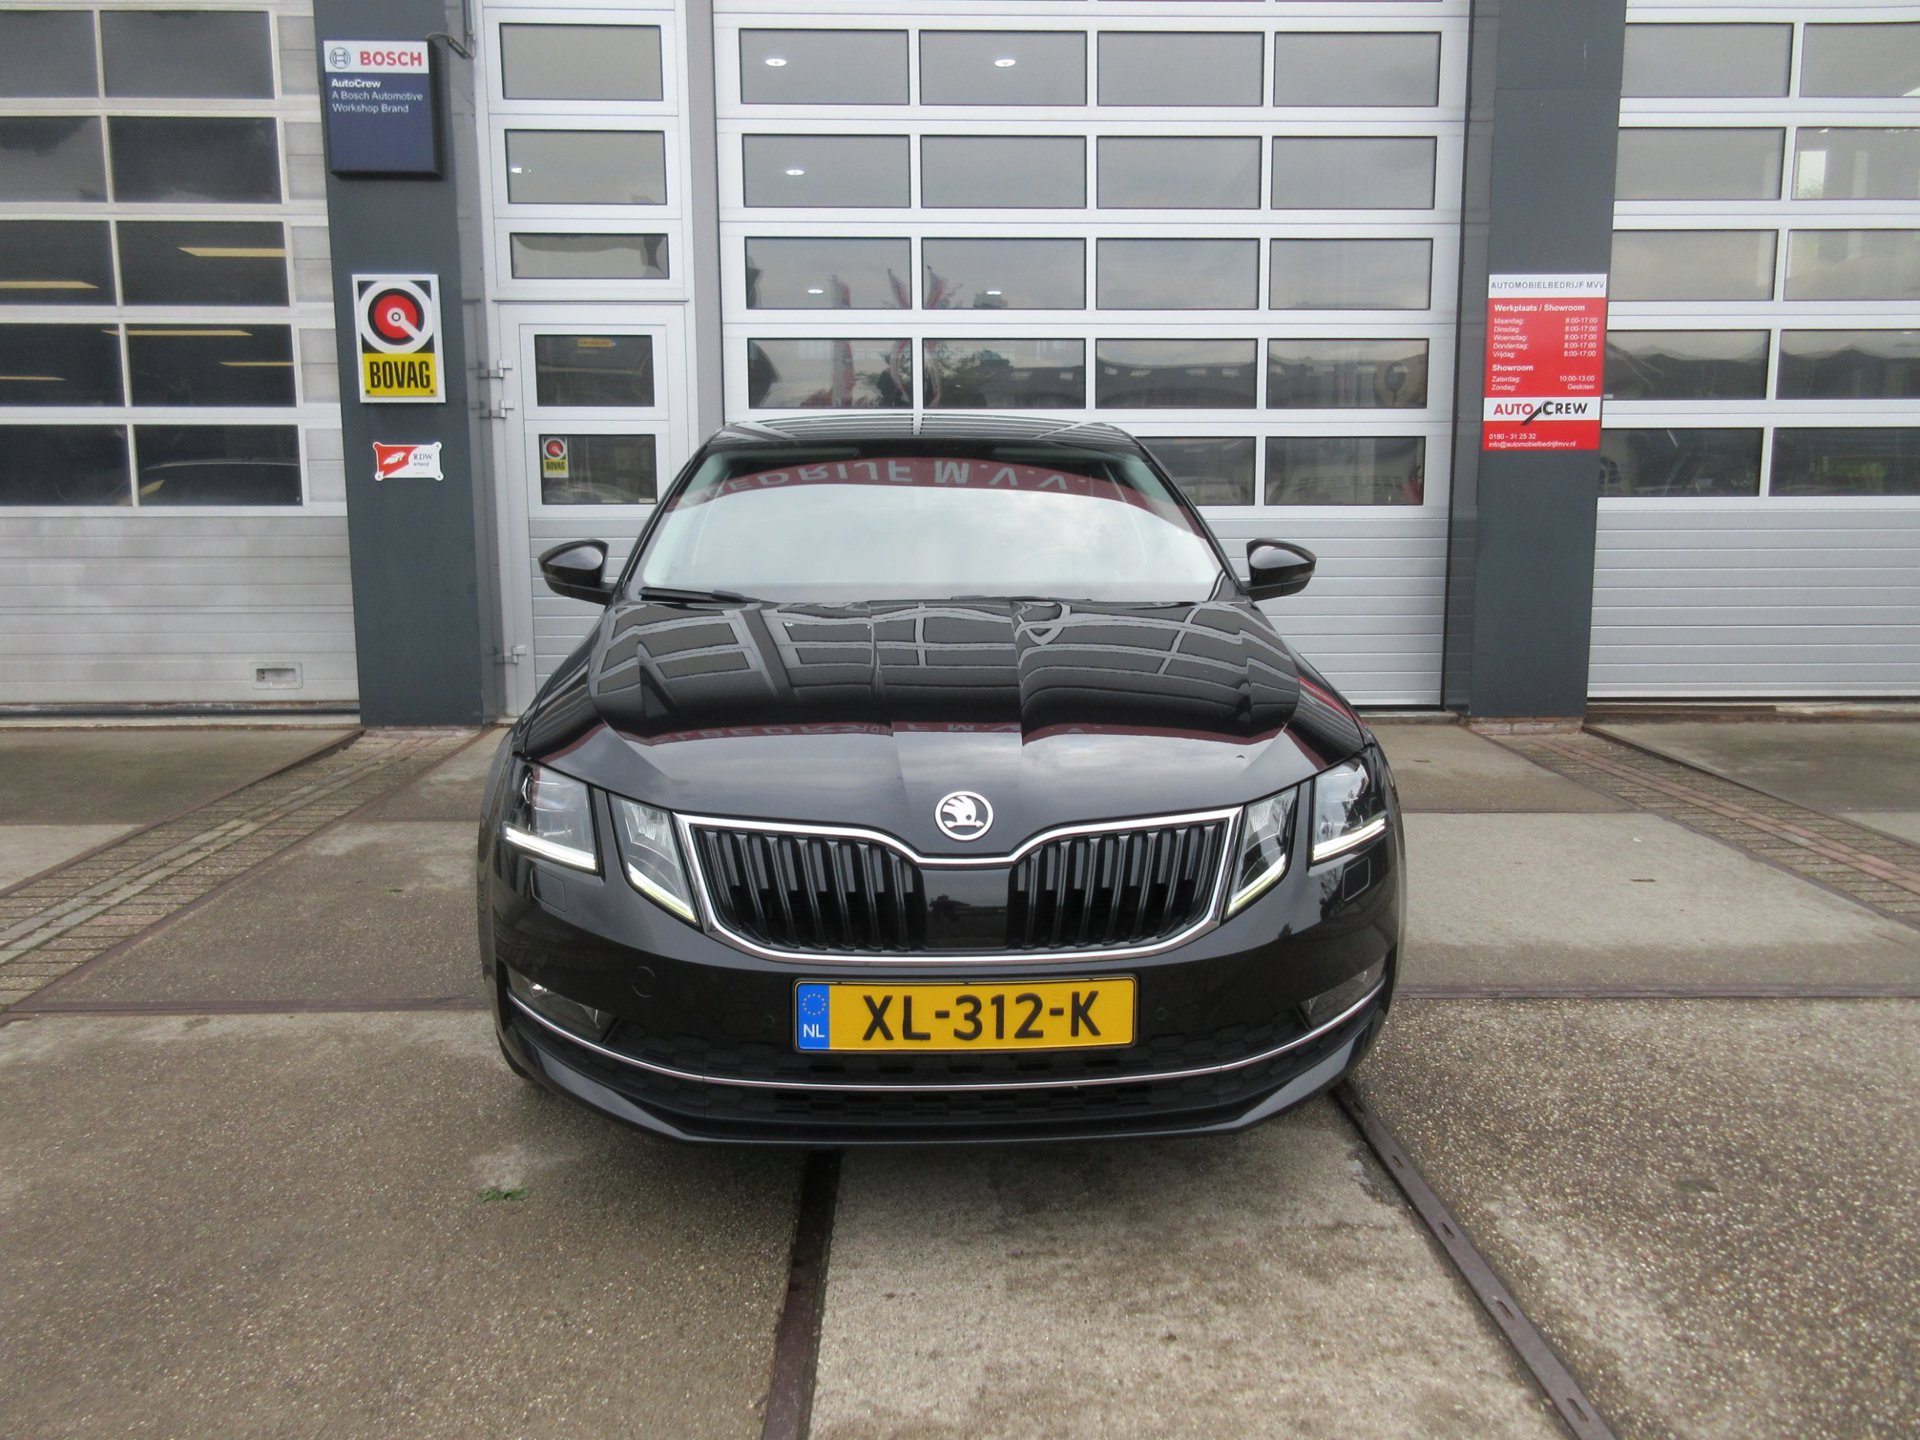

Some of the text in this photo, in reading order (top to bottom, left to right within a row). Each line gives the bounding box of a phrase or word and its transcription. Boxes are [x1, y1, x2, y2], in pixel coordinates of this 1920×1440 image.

[360, 51, 422, 66] BOSCH
[331, 79, 381, 88] AutoCrew
[341, 92, 370, 100] Bosch
[372, 92, 423, 100] Automotive
[332, 103, 409, 114] Workshop Brand
[1491, 281, 1604, 289] AUTOMOBIELBEDRIJF MVV
[1494, 304, 1537, 313] Werkplaats
[1494, 317, 1524, 325] Maandag:
[1494, 326, 1520, 334] Dinsdag:
[1493, 334, 1528, 342] Woensdag:
[1493, 342, 1528, 350] Donderdag:
[1493, 350, 1515, 359] Vrijdag:
[369, 361, 430, 389] BOVAG
[1493, 403, 1534, 415] AUTO
[862, 990, 1101, 1041] XL-312-K
[803, 1024, 825, 1038] NL
